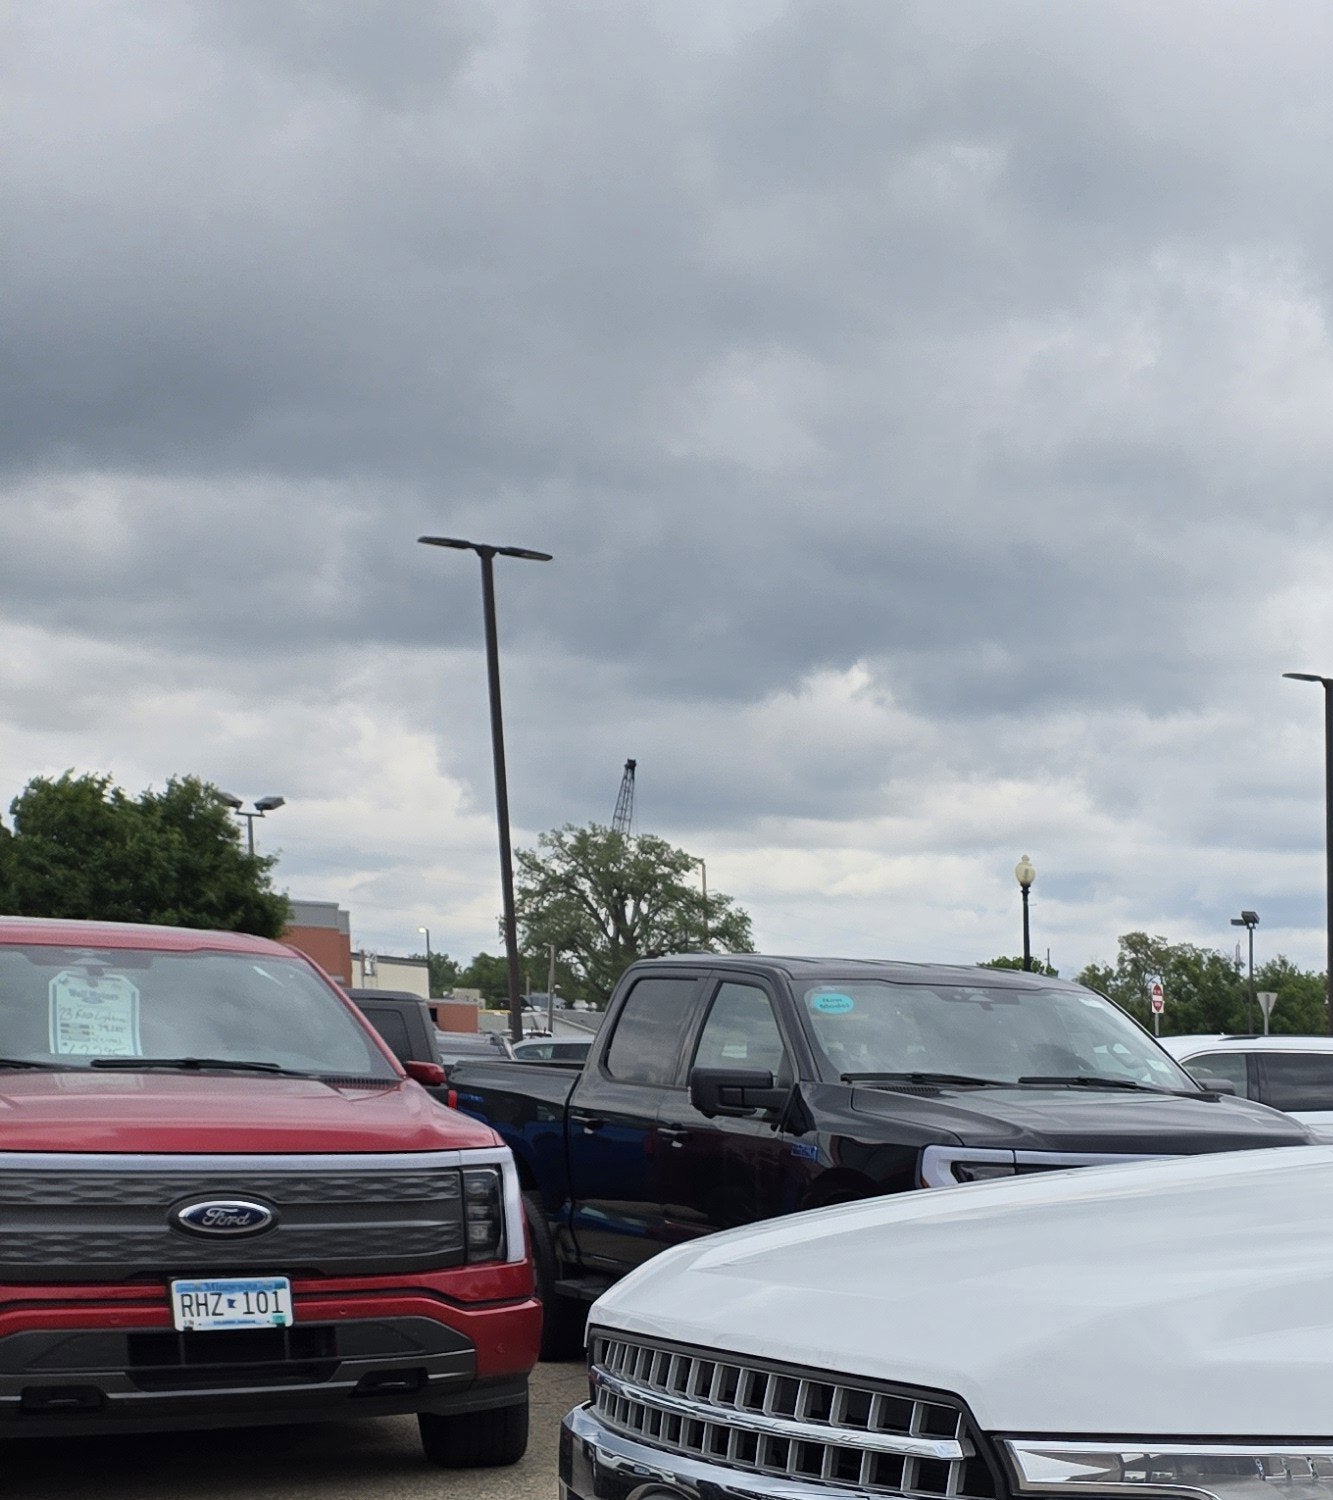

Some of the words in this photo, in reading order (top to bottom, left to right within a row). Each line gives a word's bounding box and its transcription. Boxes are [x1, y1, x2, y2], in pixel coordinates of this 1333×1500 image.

[202, 1207, 250, 1226] Ford
[180, 1292, 224, 1317] RHZ
[243, 1291, 284, 1314] 101
